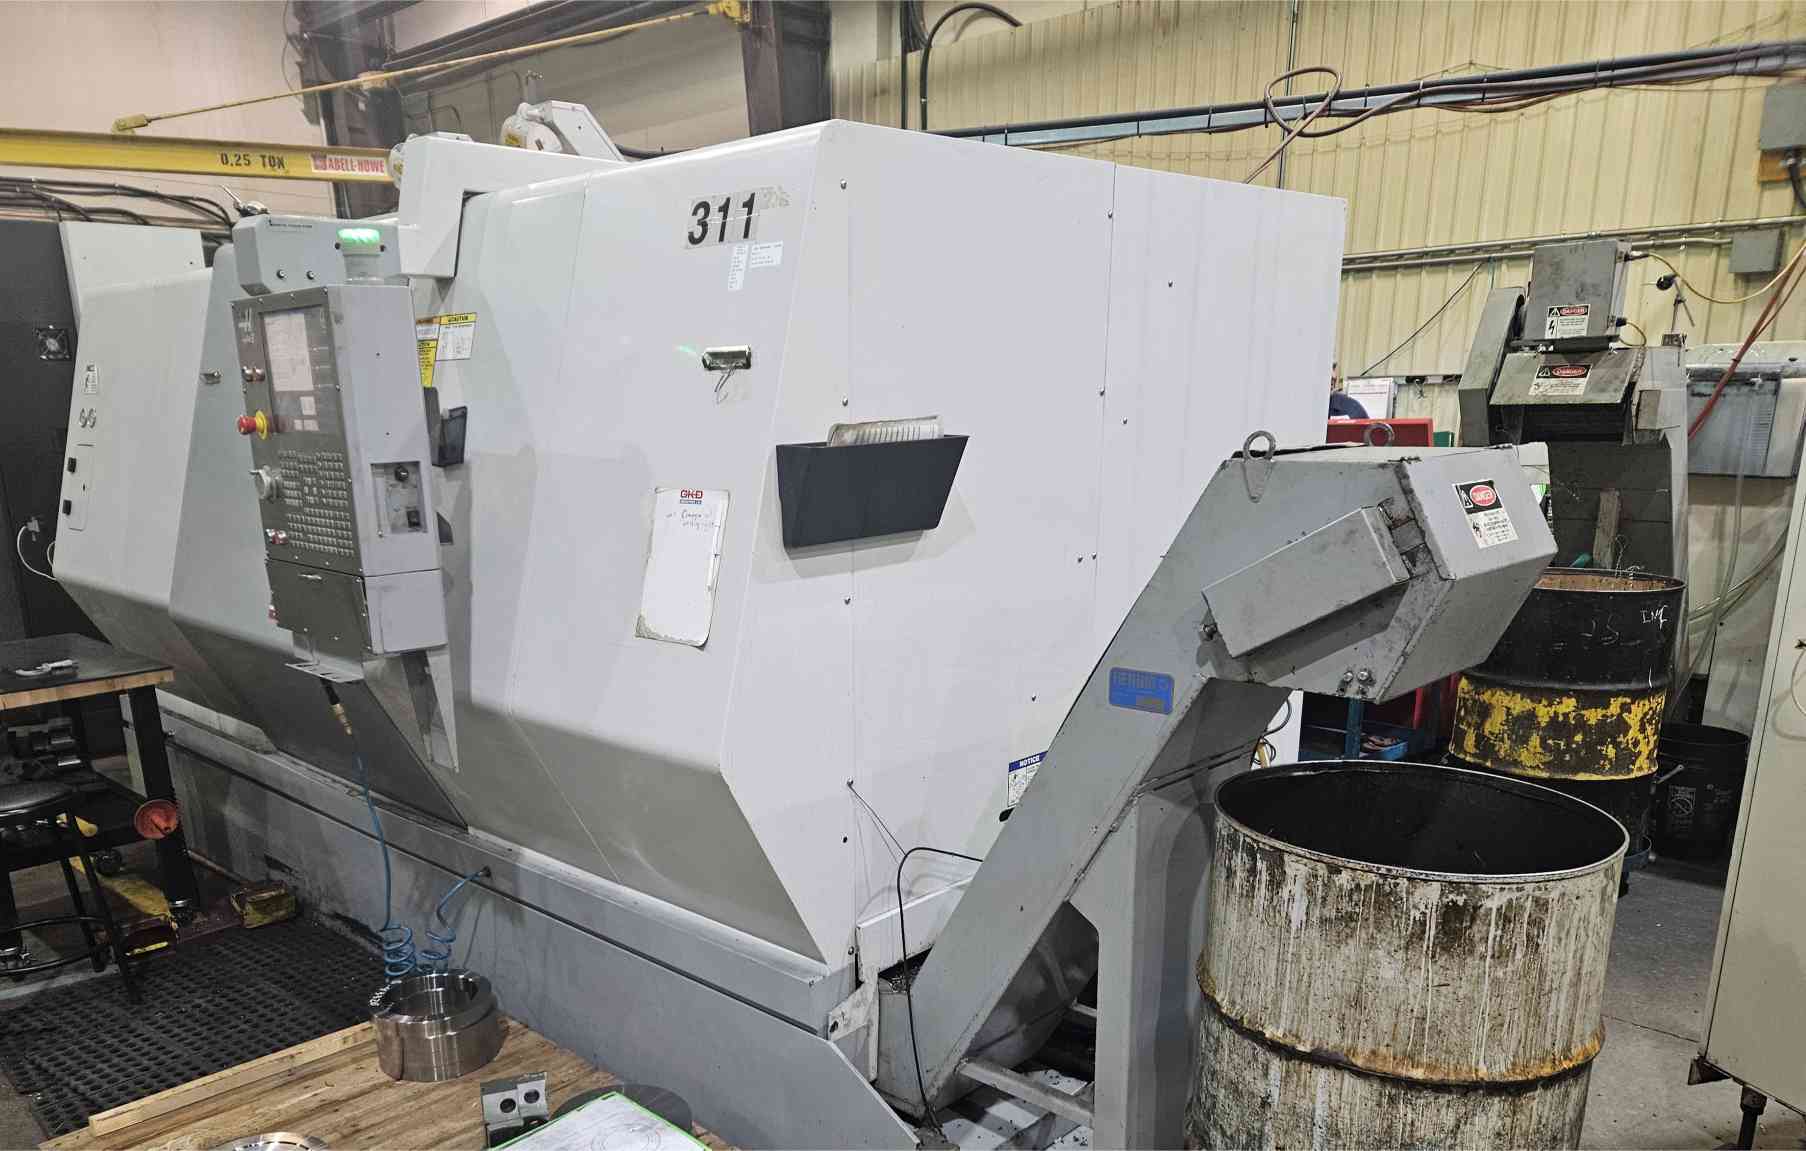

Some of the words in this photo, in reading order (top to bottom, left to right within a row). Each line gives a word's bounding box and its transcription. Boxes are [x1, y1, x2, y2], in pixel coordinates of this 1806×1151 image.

[220, 152, 251, 167] 0.25
[260, 154, 286, 169] TON
[688, 192, 755, 245] 311
[1020, 754, 1040, 767] NOTICE
